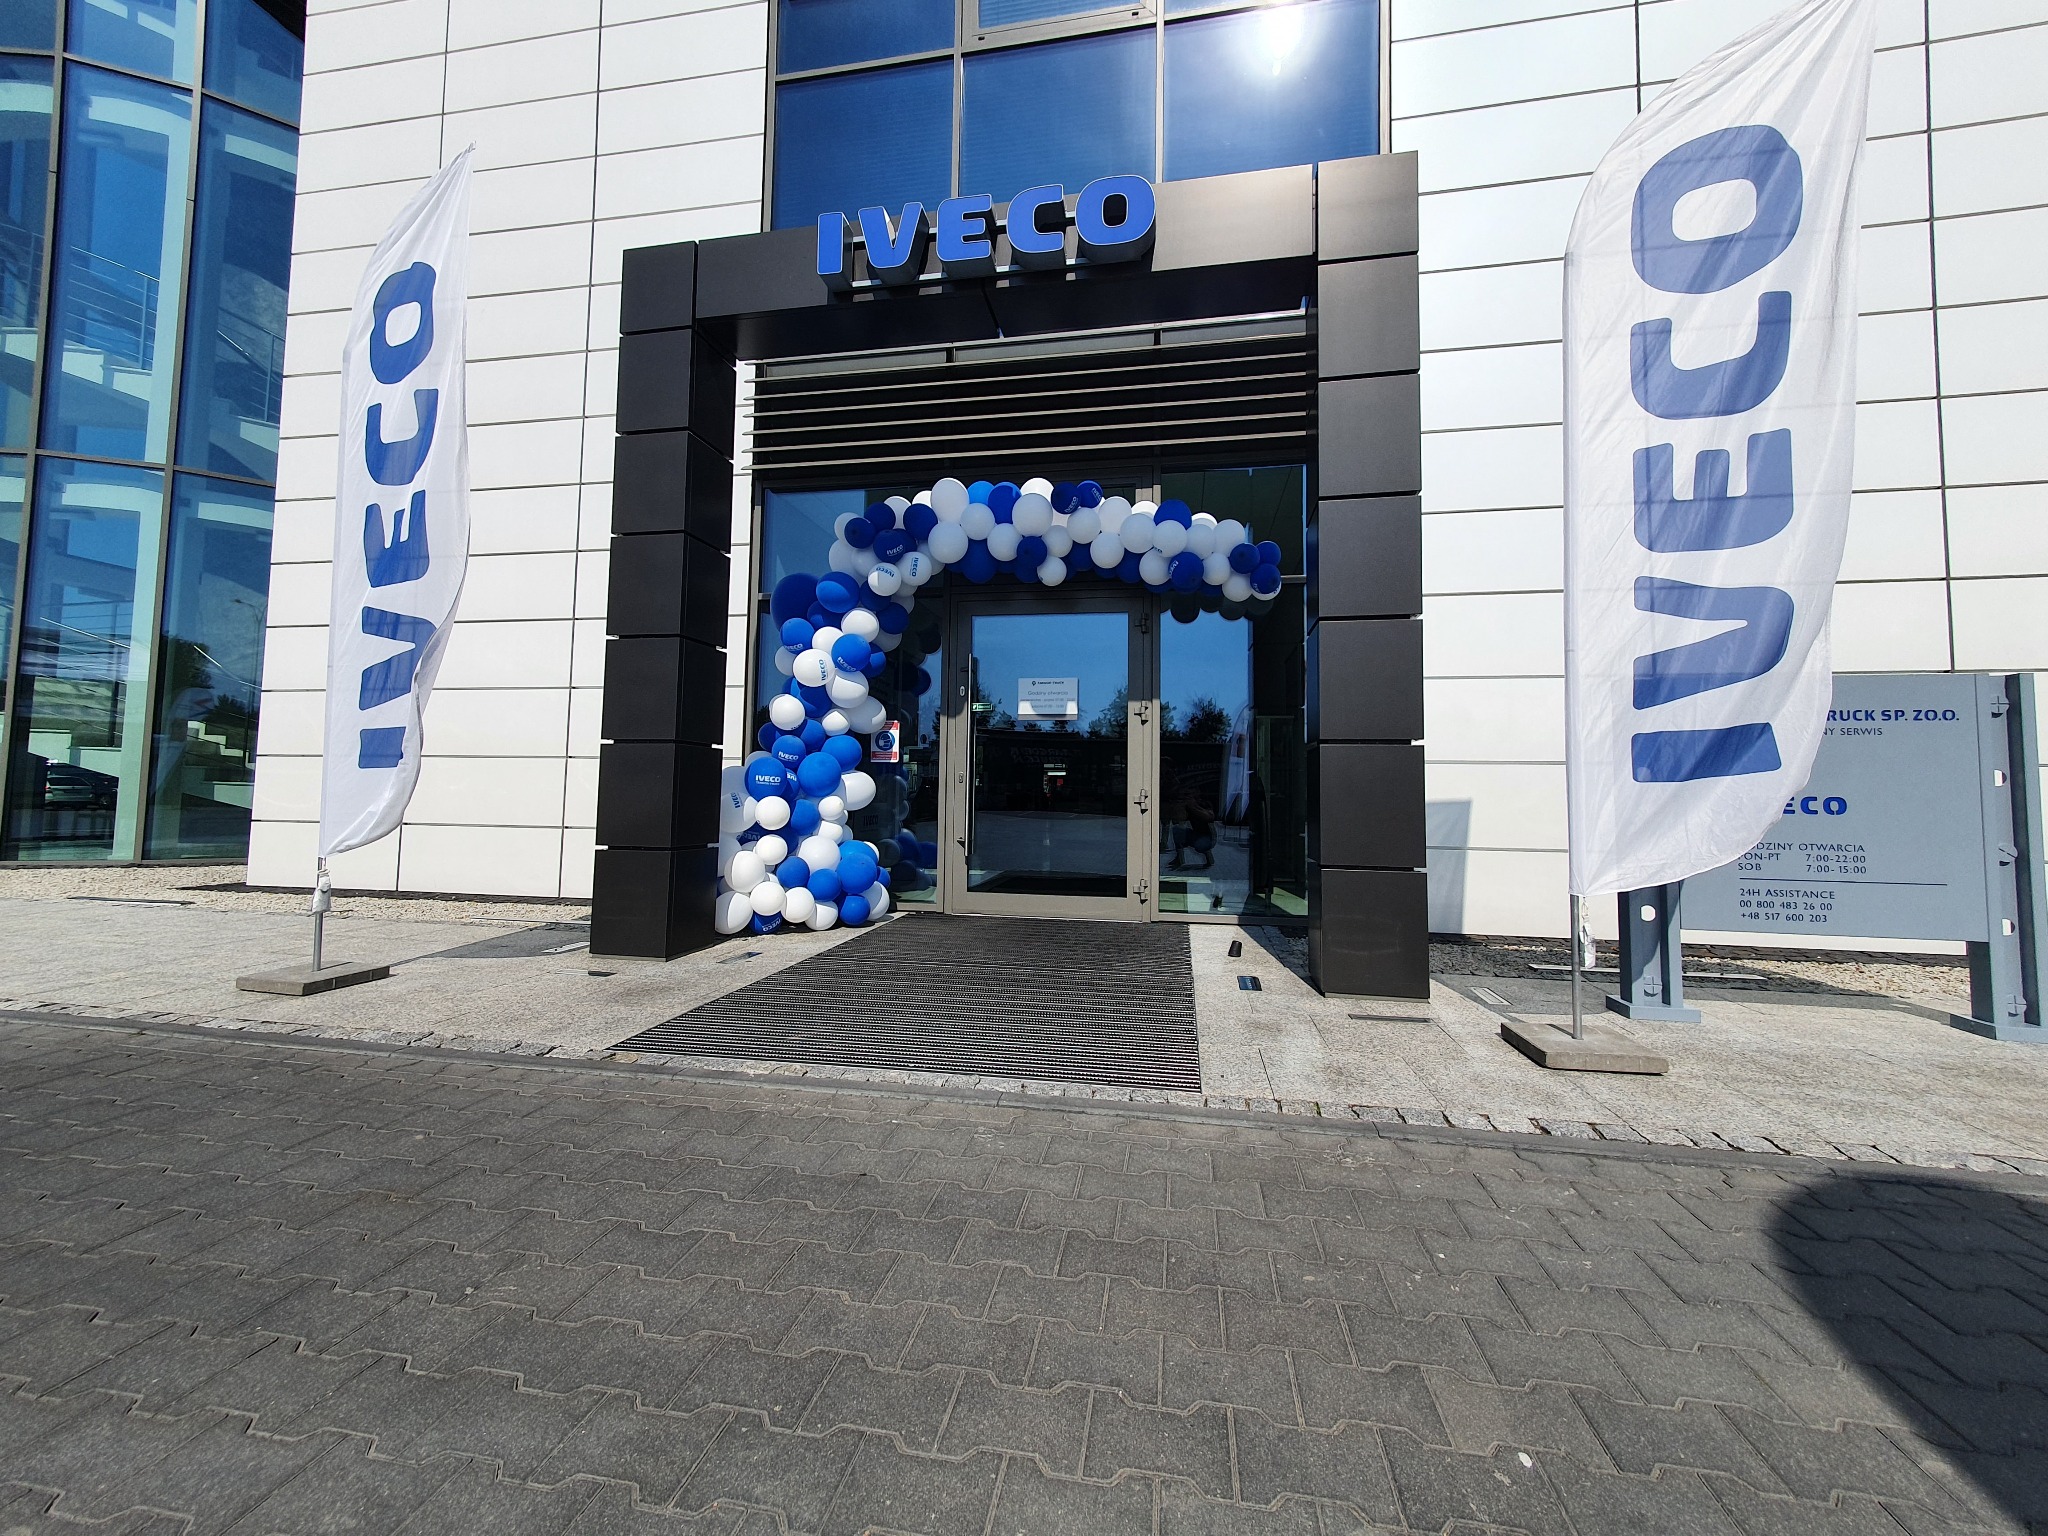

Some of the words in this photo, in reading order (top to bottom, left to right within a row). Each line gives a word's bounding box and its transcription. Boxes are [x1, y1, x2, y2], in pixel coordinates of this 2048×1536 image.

[817, 174, 1157, 275] IVECO
[1631, 124, 1803, 783] IVECO
[358, 261, 440, 769] IVECO
[911, 557, 920, 577] IVECO
[819, 659, 827, 681] IVECO
[836, 656, 857, 672] IVECO
[1826, 709, 1876, 721] RUCK
[1881, 709, 1908, 721] SP.
[1839, 727, 1883, 736] SERWIS
[778, 751, 799, 760] IVECO
[755, 774, 781, 783] IVECO
[1782, 796, 1848, 816] ECO
[1752, 842, 1794, 851] DZINY
[1798, 843, 1866, 853] OTWARCIA
[1805, 853, 1866, 864] 7:00-22:00
[1737, 862, 1762, 871] SOB
[1739, 888, 1760, 897] 24H
[1764, 888, 1836, 900] ASSISTANCE
[1739, 900, 1752, 908] 00
[1756, 900, 1775, 909] 800
[1779, 901, 1798, 910] 483
[1803, 902, 1815, 911] 26
[1819, 902, 1833, 911] 00
[1741, 911, 1760, 920] +48
[1764, 912, 1780, 921] 517
[1785, 913, 1804, 922] 600
[1809, 914, 1828, 923] 203
